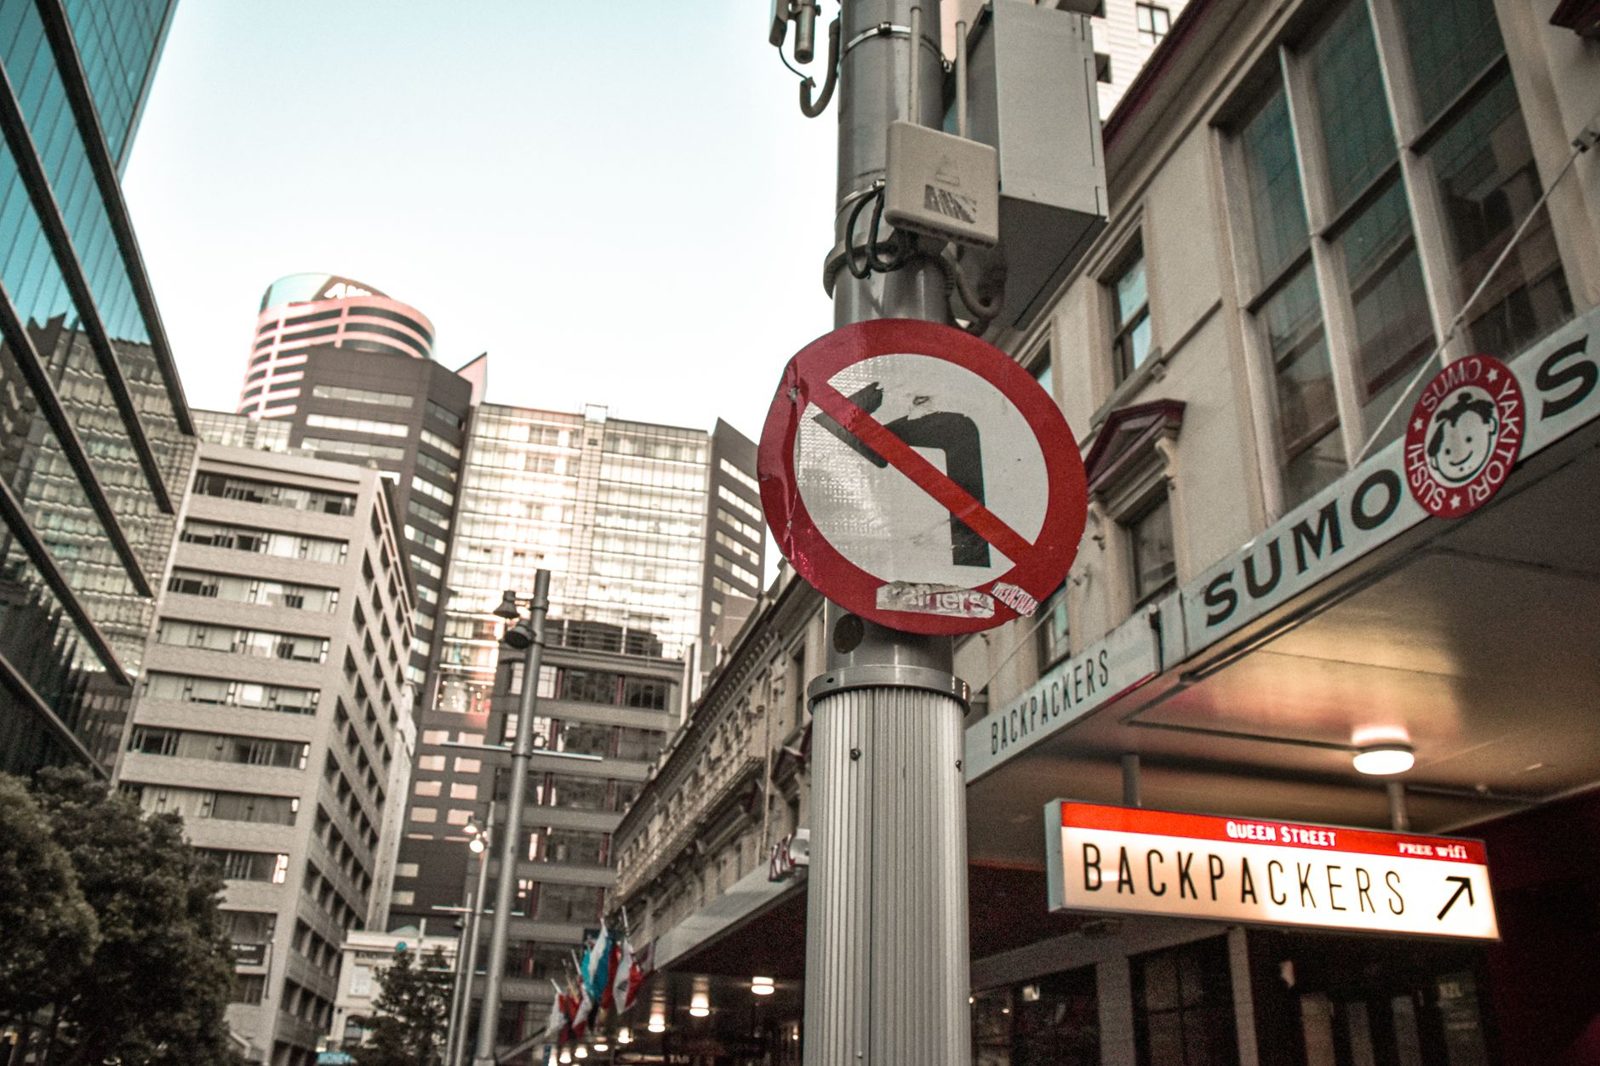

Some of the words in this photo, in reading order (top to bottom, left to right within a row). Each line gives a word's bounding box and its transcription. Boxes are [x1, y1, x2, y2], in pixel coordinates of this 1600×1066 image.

[1421, 358, 1482, 412] SUMO
[1407, 443, 1447, 511] SUSHI
[1467, 378, 1520, 507] YAKITORI
[1203, 468, 1402, 627] SUMO
[991, 649, 1109, 755] BACKPACKERS
[1226, 821, 1276, 841] QUEEN
[1280, 826, 1336, 846] STREET
[1398, 842, 1433, 856] FREE
[1083, 843, 1405, 915] BACKPACKERS
